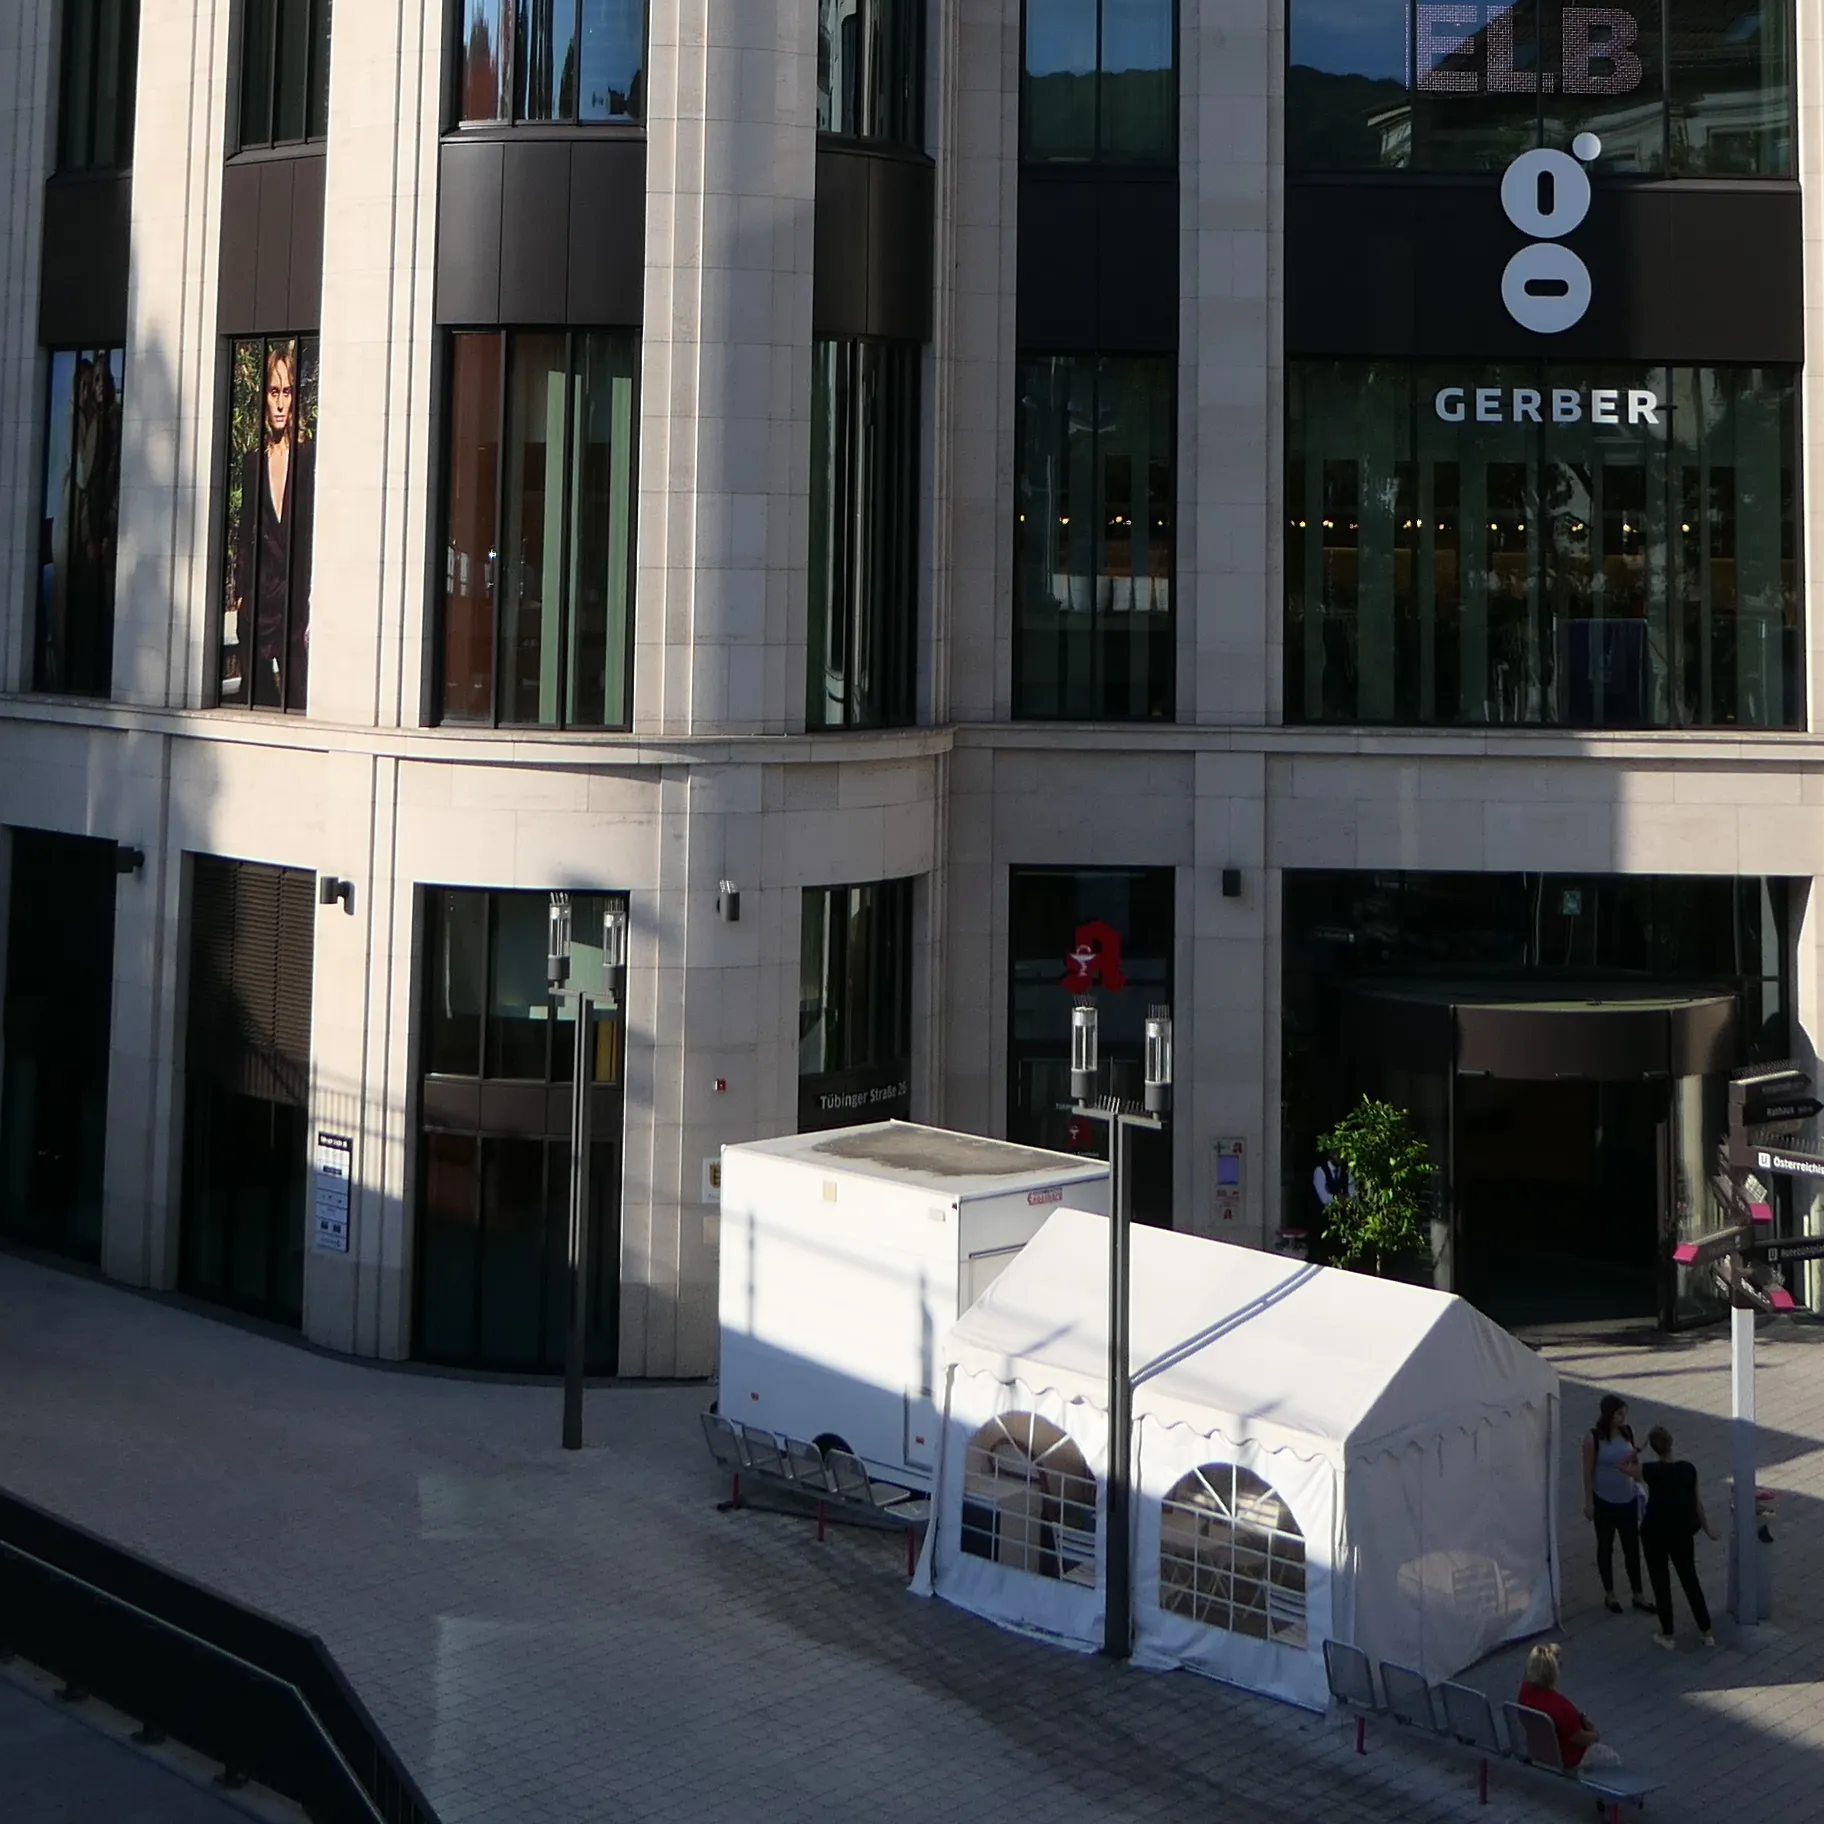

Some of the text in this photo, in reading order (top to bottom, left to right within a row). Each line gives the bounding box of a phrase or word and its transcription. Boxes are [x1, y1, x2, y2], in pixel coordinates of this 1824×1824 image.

[1405, 4, 1643, 95] ELB
[1434, 387, 1660, 426] GERBER
[820, 1092, 868, 1110] Tübinger
[870, 1083, 897, 1104] Straße
